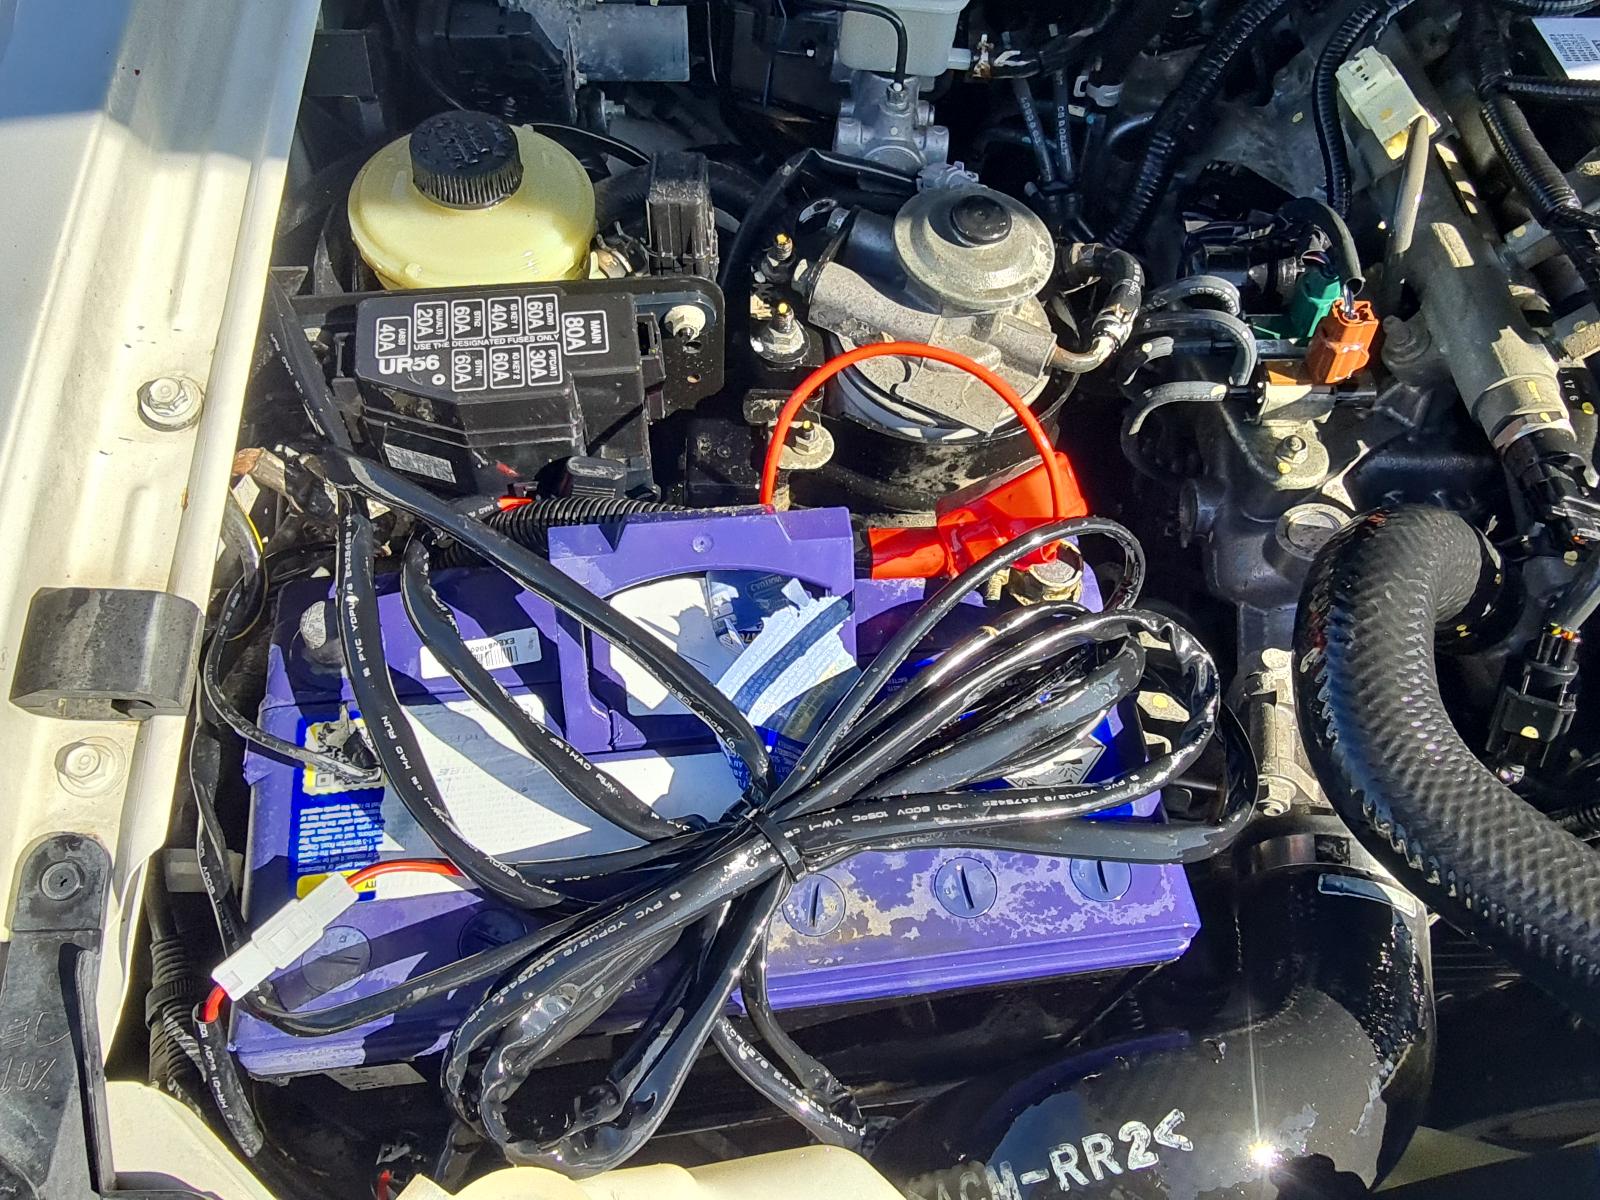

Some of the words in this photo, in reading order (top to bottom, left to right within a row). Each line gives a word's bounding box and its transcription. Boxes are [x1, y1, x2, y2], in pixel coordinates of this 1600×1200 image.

[417, 309, 433, 337] 20A
[454, 306, 471, 334] 60A
[491, 303, 508, 332] 40A
[527, 301, 545, 329] 60A
[378, 323, 396, 352] 40A
[413, 342, 432, 351] USE
[433, 341, 450, 350] THE
[451, 337, 506, 348] DESIGNATED
[507, 335, 535, 344] FUSES
[537, 333, 559, 341] ONLY
[565, 317, 586, 350] 80A
[590, 320, 602, 344] MAIN
[378, 354, 440, 375] UR56
[454, 355, 472, 384] 60A
[492, 352, 510, 382] 60A
[512, 360, 520, 373] KEY
[529, 349, 548, 379] 30A
[1563, 379, 1575, 389] 17
[355, 638, 366, 662] PVC
[381, 715, 397, 739] RUN
[569, 750, 592, 771] HAO
[1103, 780, 1126, 790] PVC
[896, 805, 931, 816] 600V
[808, 818, 844, 832] VW-1
[635, 900, 665, 920] PVC
[212, 1076, 229, 1109] HR-01
